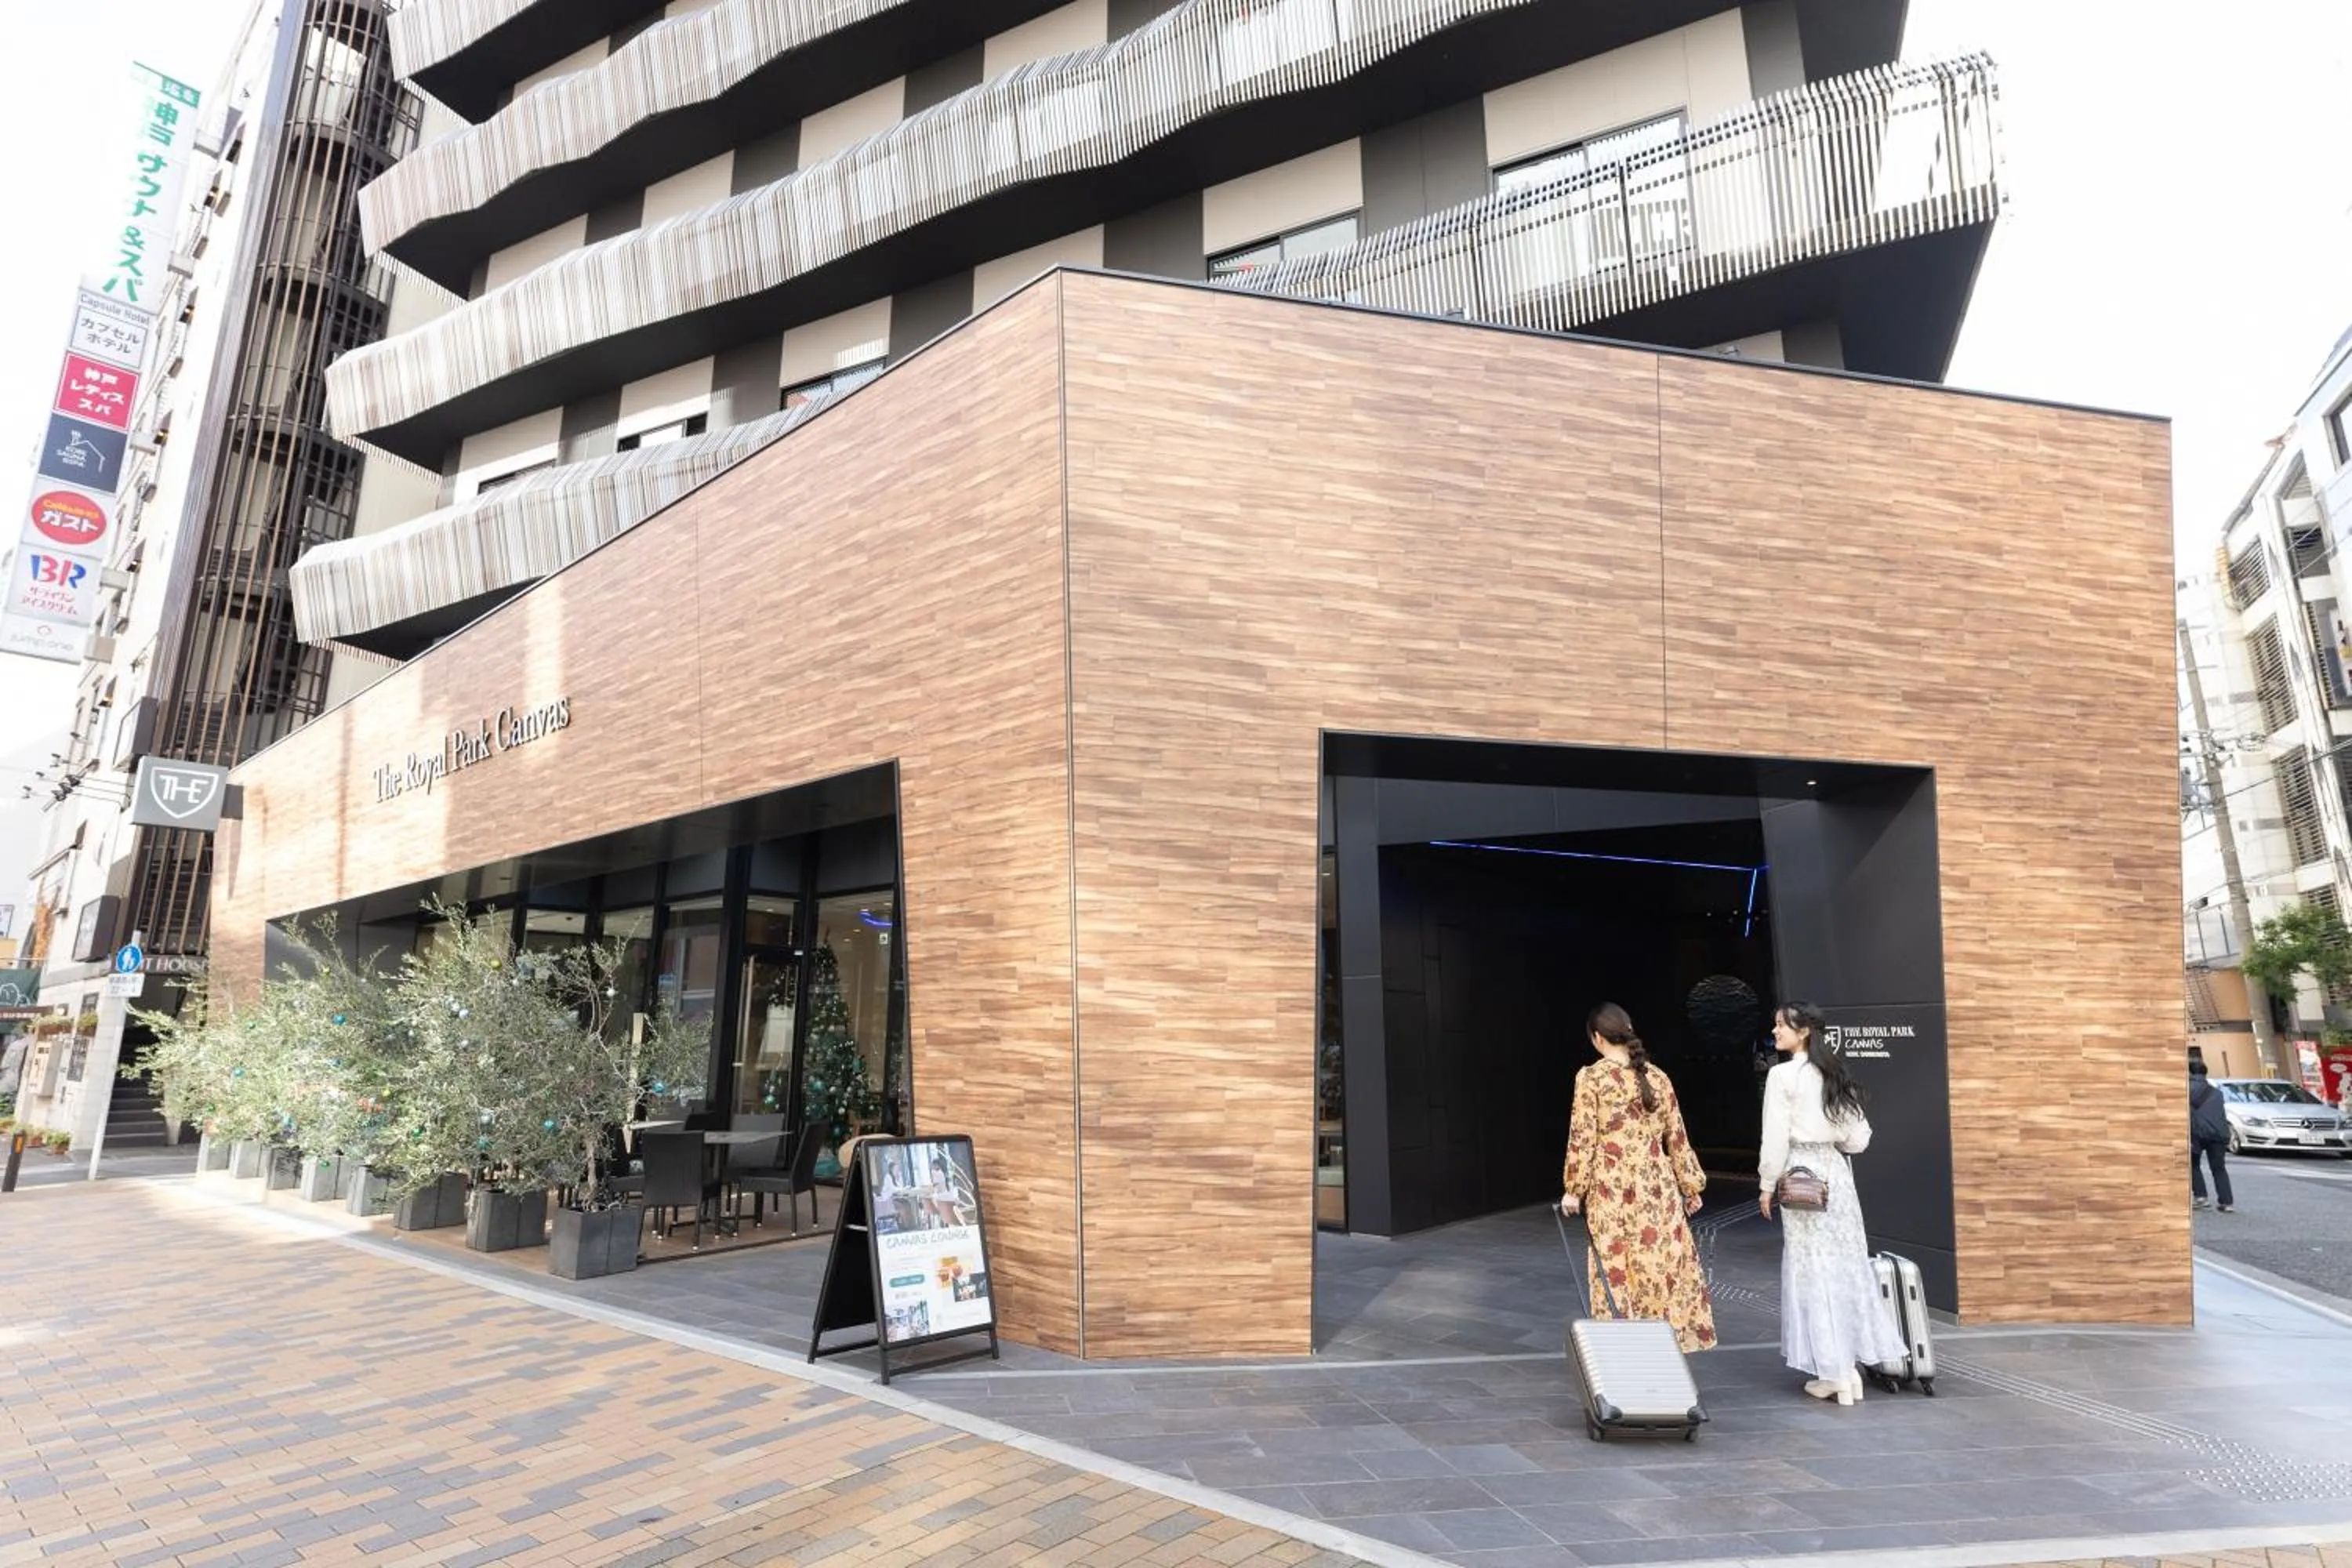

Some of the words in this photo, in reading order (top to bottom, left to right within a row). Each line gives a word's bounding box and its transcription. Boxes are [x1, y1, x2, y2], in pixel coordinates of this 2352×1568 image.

[87, 333, 132, 354] ホテル
[40, 510, 100, 532] ガスト
[373, 762, 402, 804] The
[405, 735, 448, 795] Royal
[451, 719, 492, 772] Park
[495, 696, 572, 752] Canvas
[1862, 1026, 1889, 1037] ROYAL
[1890, 1025, 1915, 1036] PARK
[1845, 1039, 1884, 1049] CANVAS
